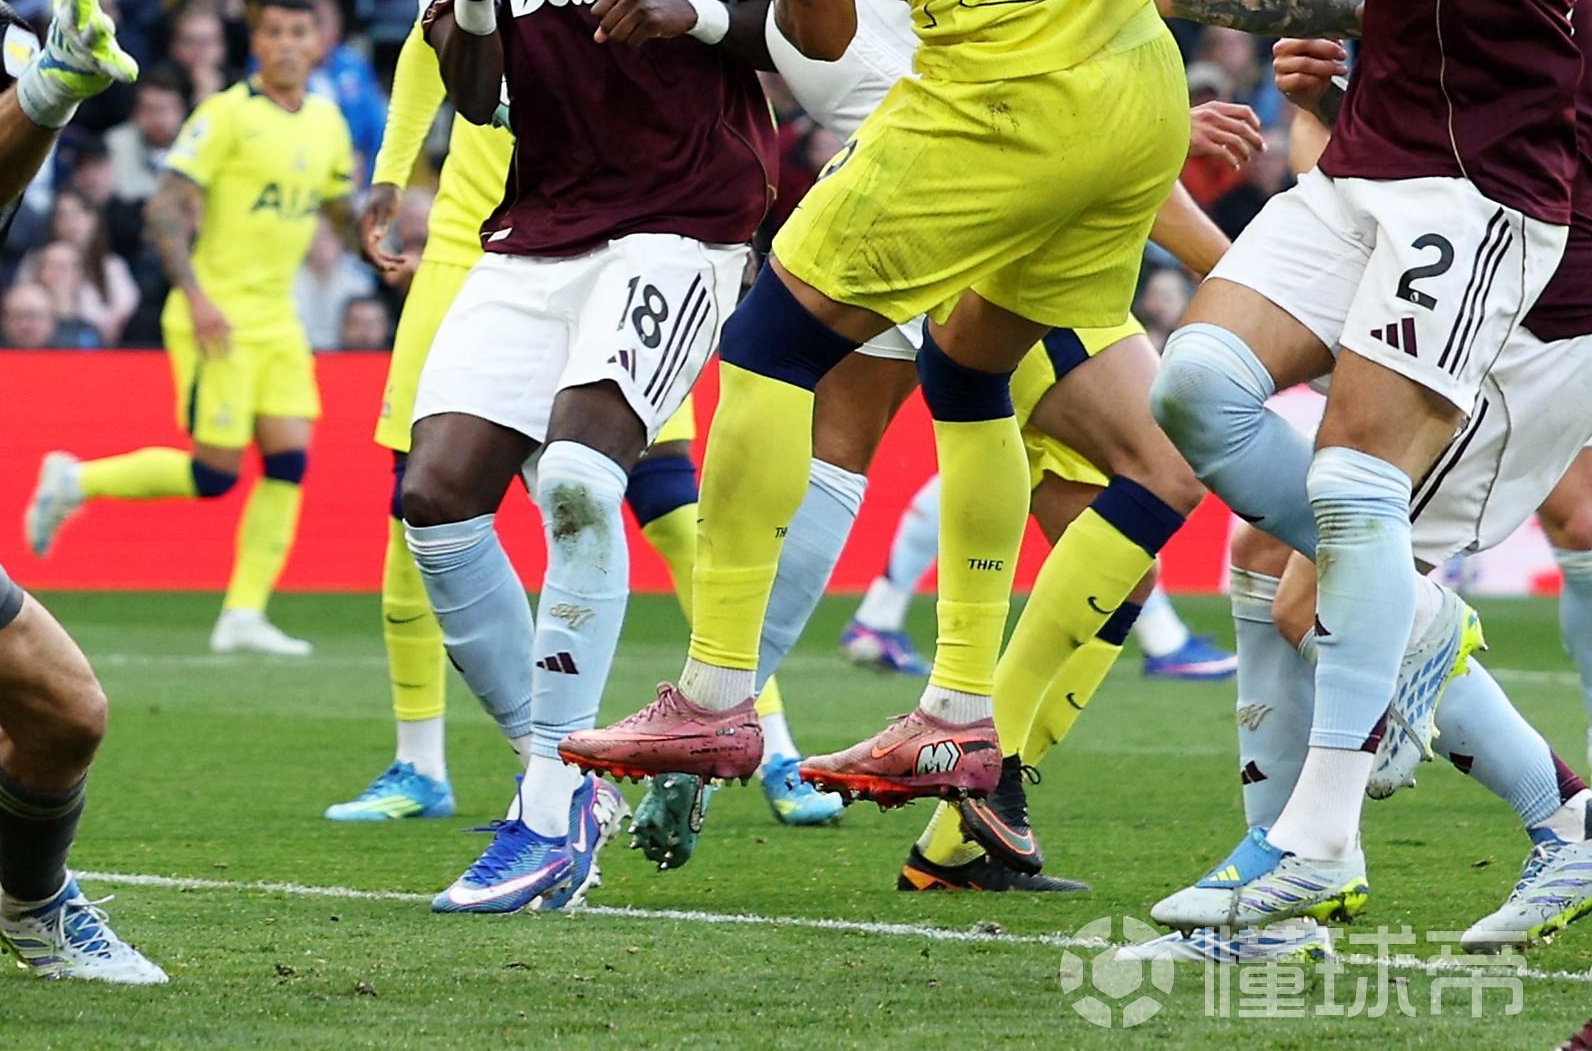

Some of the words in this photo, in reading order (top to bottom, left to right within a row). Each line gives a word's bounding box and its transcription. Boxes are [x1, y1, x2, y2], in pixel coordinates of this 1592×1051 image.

[1396, 233, 1454, 311] 2
[617, 275, 669, 349] 18
[775, 526, 788, 538] TH
[967, 558, 1004, 571] THFC
